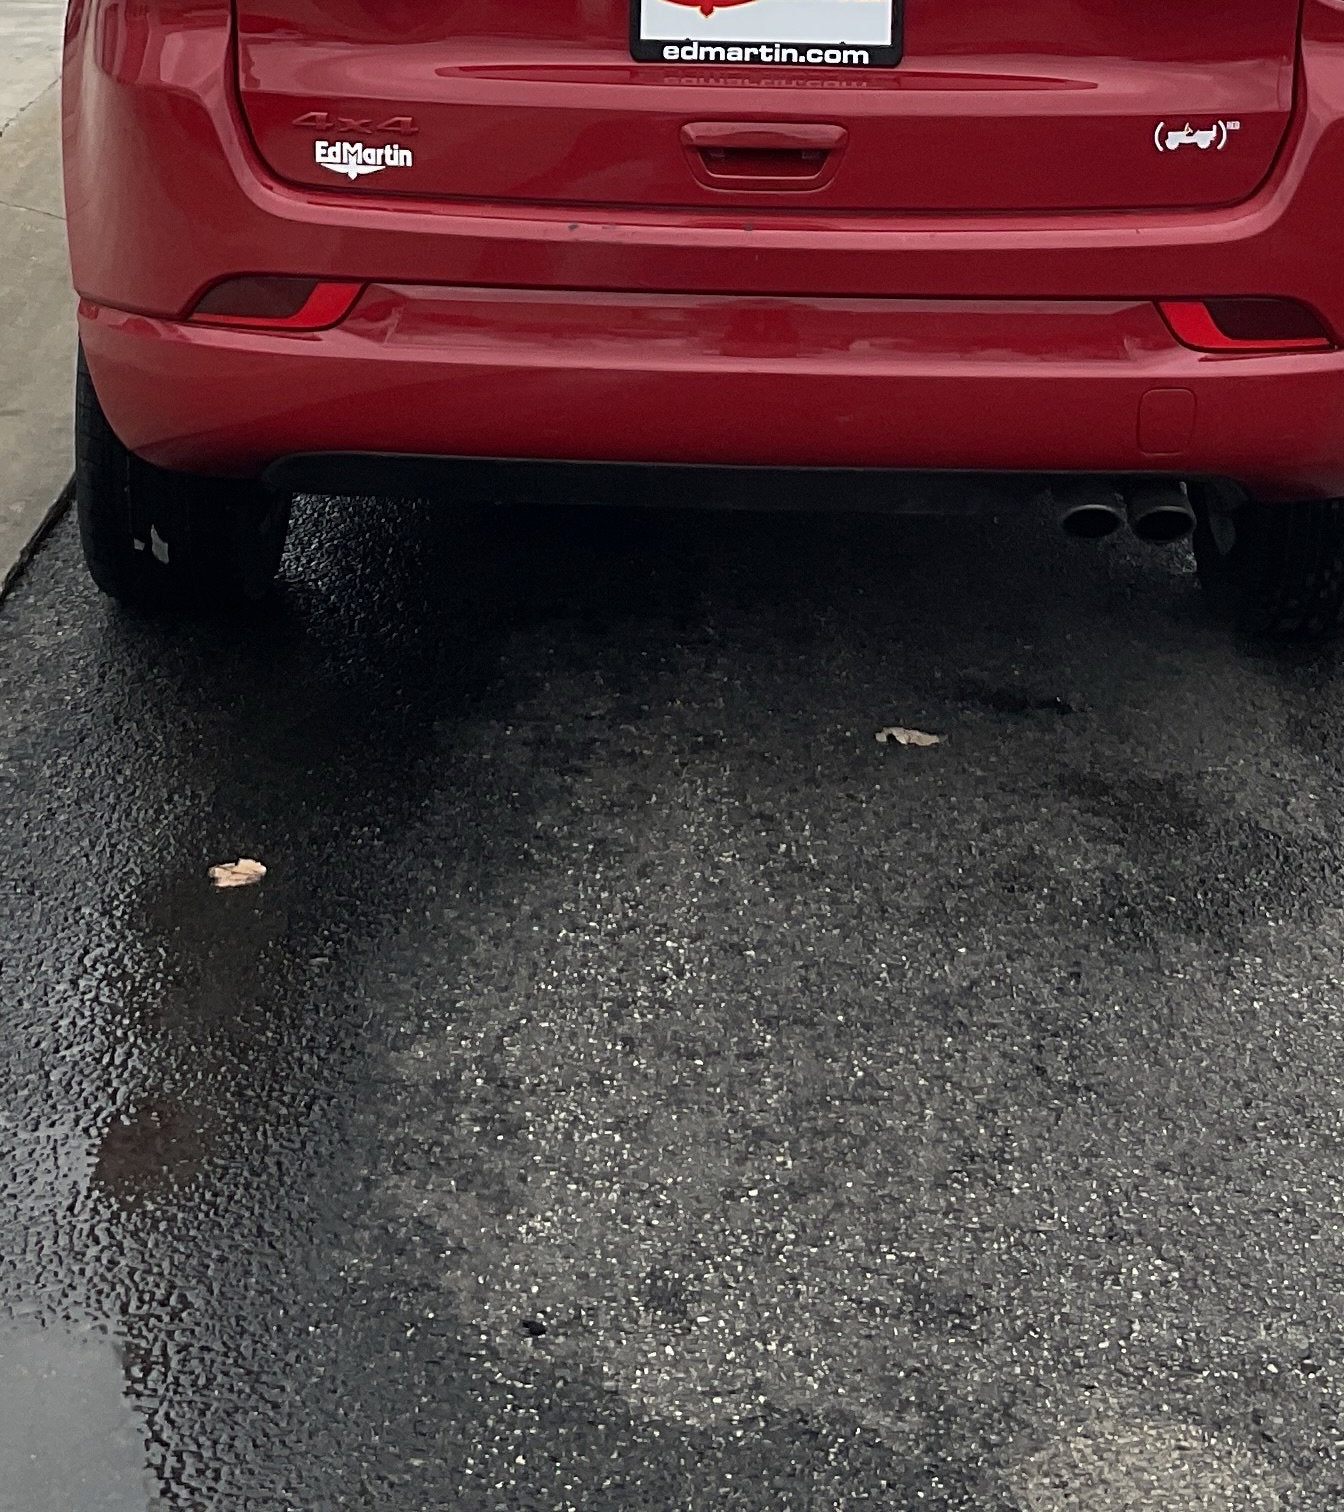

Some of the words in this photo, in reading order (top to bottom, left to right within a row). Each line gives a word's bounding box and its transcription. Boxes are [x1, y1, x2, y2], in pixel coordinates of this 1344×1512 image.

[663, 42, 870, 64] edmartin.com
[292, 111, 419, 135] 4x4
[315, 140, 413, 170] EdMartin
